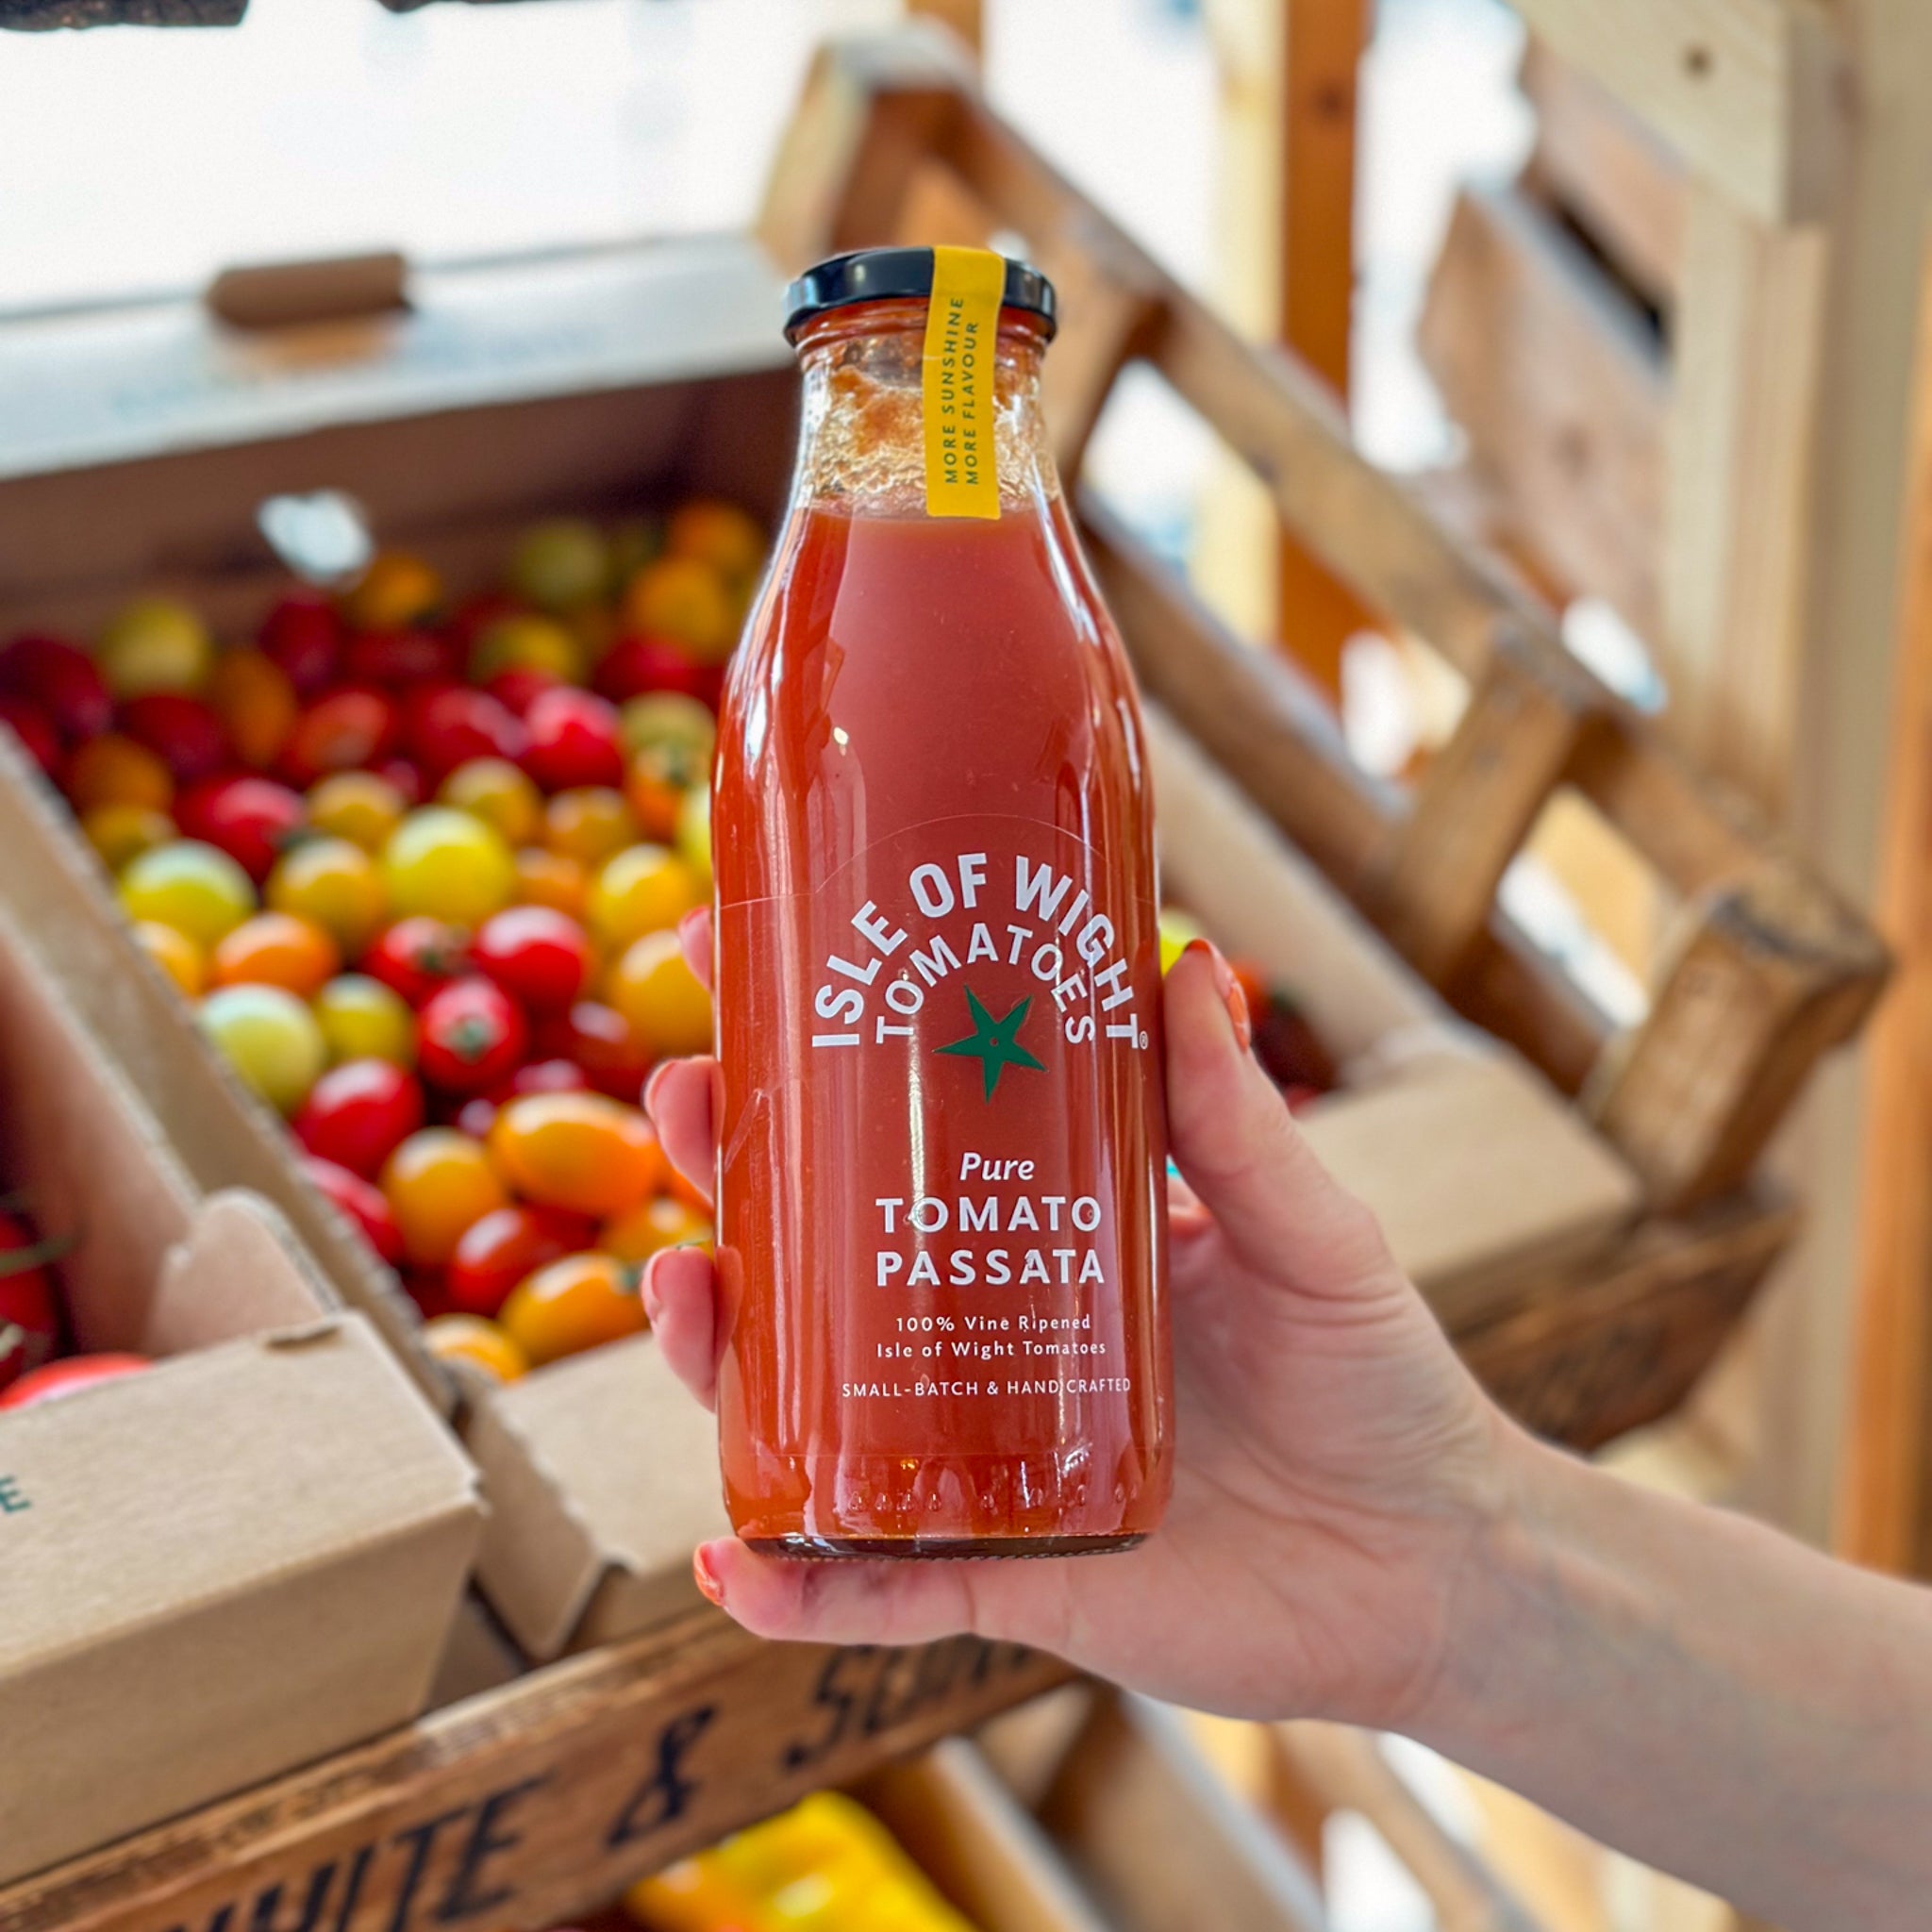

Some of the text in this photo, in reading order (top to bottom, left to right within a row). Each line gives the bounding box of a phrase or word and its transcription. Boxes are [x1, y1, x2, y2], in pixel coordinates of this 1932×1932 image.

[941, 297, 964, 485] MORE SUNSHINE
[961, 322, 979, 485] MORE FLAVOUR
[811, 900, 908, 1047] ISLE
[908, 852, 987, 919] OF
[875, 922, 1096, 1045] TOMATOES
[959, 1152, 1036, 1181] Pure
[874, 1195, 1102, 1234] TOMATO
[876, 1248, 1106, 1287] PASSATA
[896, 1313, 1091, 1334] 100% Vine Ripened
[876, 1340, 1107, 1361] Isle of Wight Tomatoes
[841, 1380, 978, 1397] SMALL-BATCH
[986, 1380, 999, 1395] &
